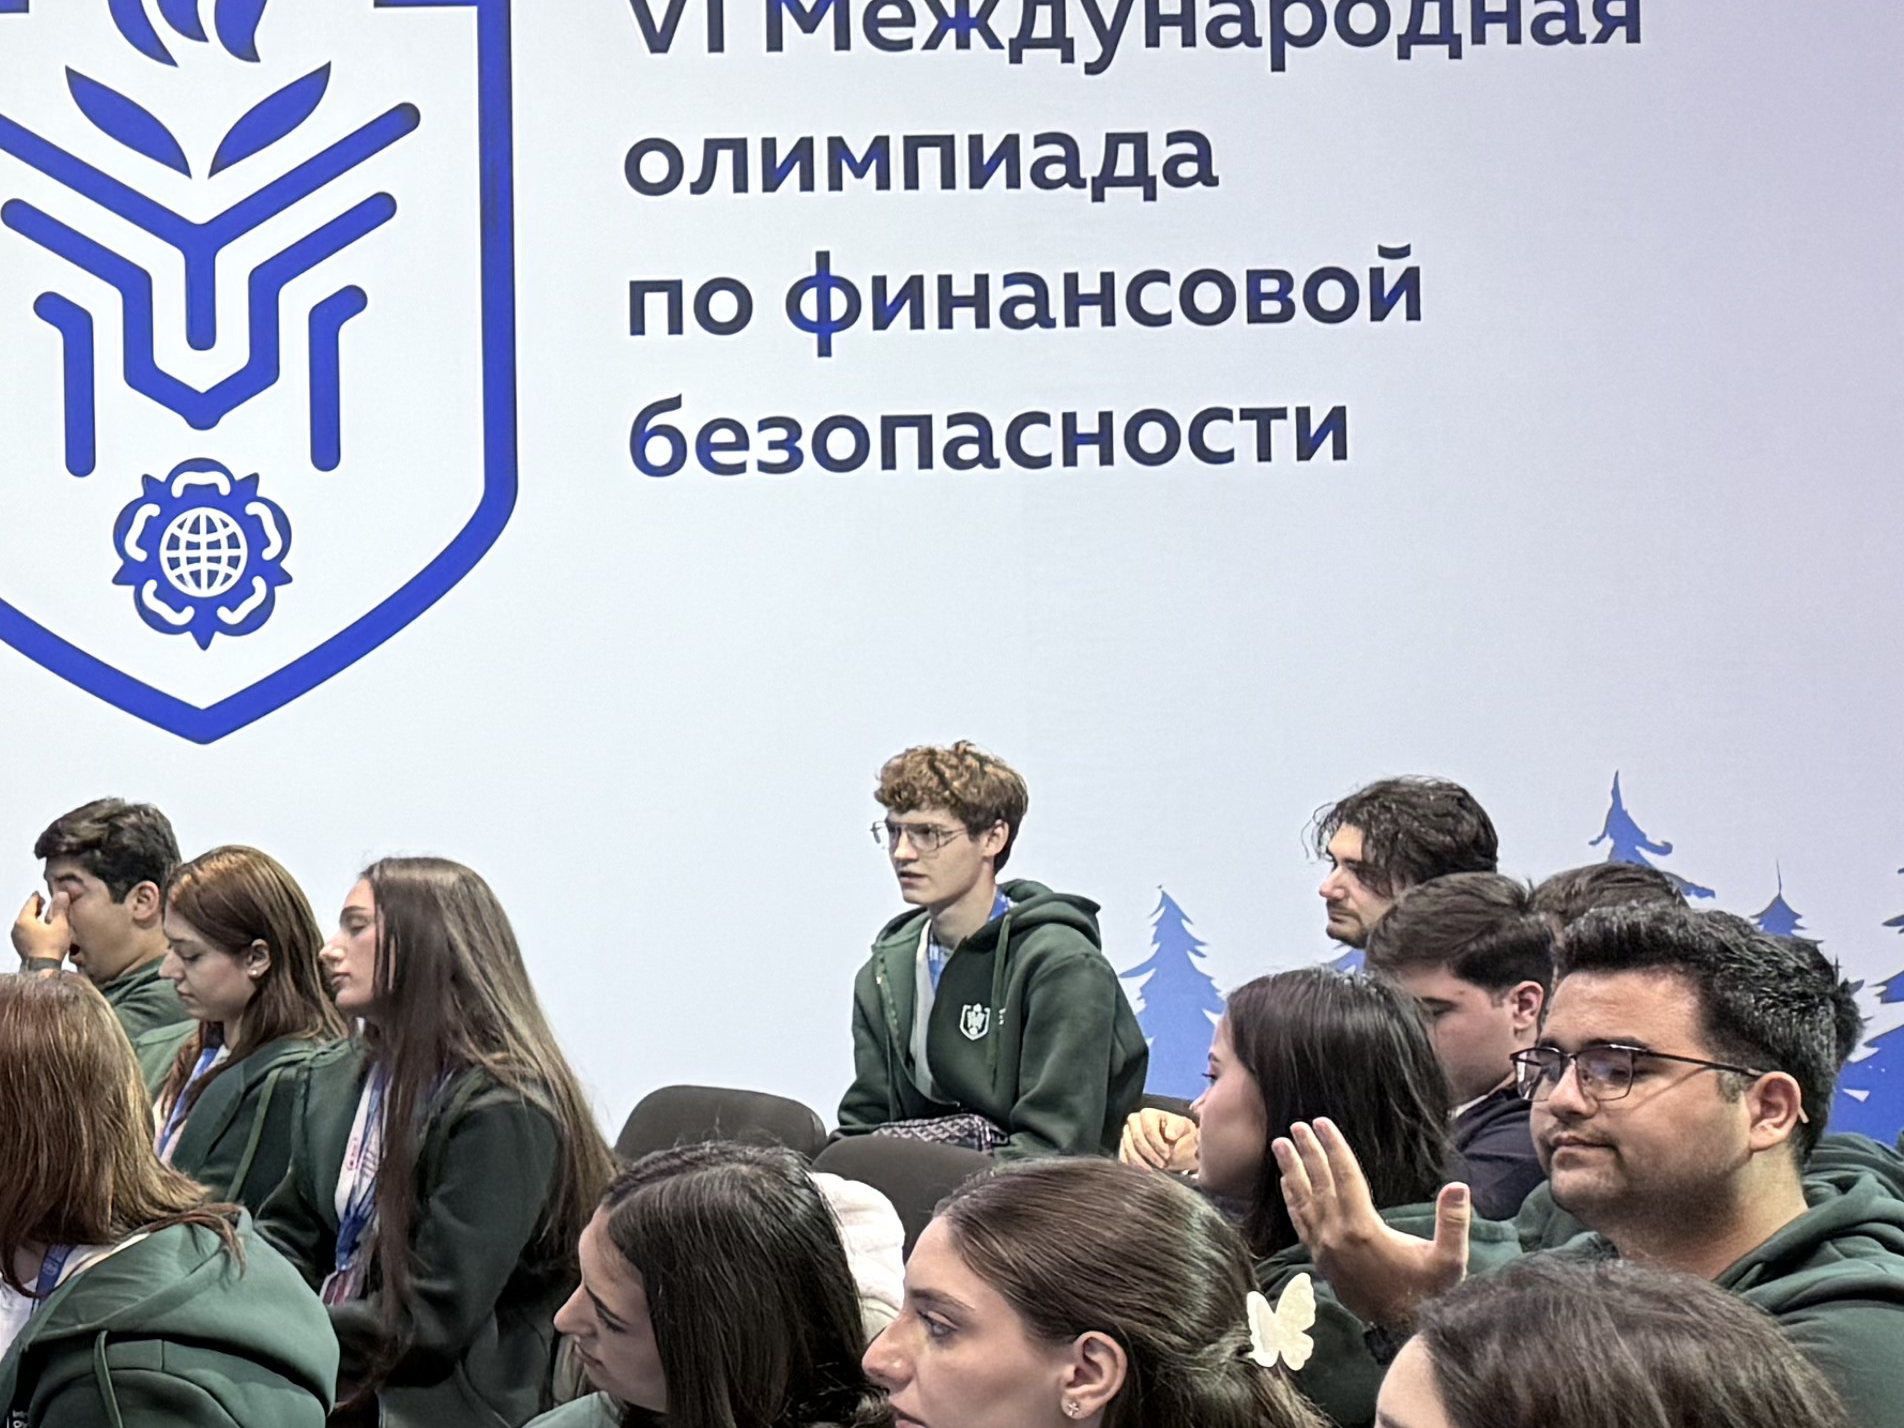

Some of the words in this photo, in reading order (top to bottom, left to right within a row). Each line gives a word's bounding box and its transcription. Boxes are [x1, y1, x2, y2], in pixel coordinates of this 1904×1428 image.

[623, 127, 1220, 203] олимпиада
[628, 273, 754, 338] по
[785, 243, 1423, 358] финансовой
[628, 395, 1349, 478] безопасности
